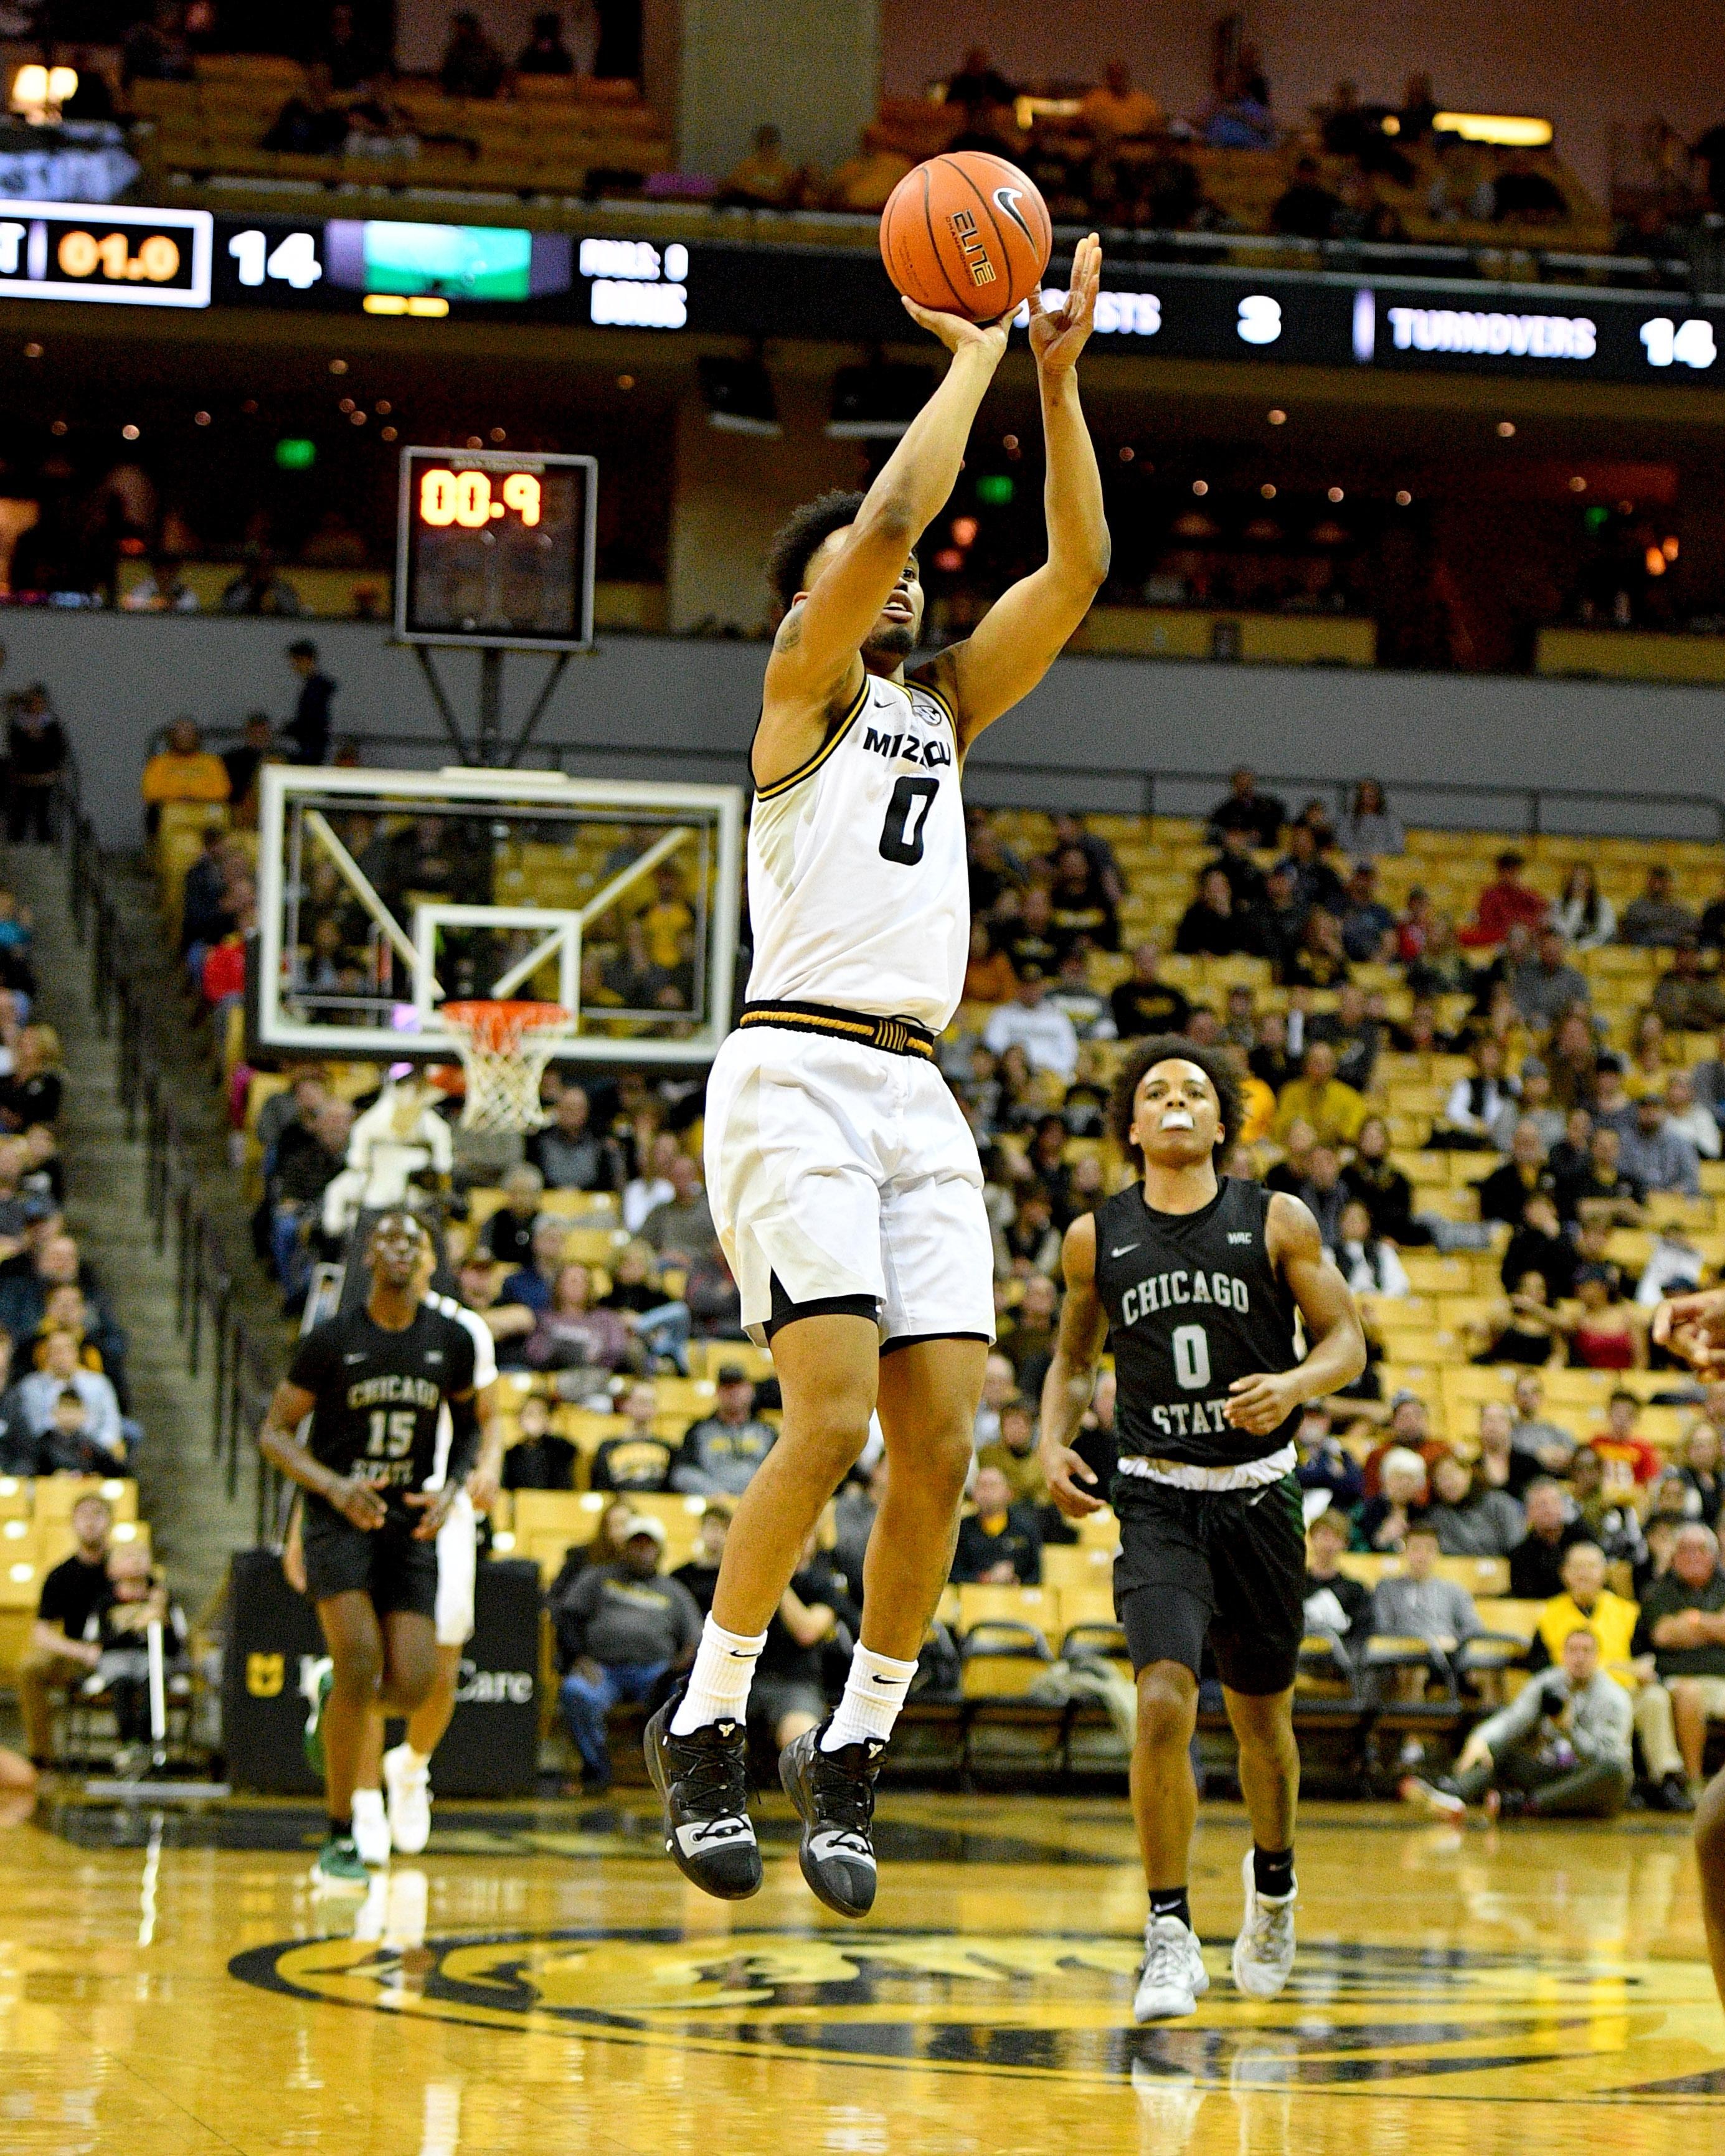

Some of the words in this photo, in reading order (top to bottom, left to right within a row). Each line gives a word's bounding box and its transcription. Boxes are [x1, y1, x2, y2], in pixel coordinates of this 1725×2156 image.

[57, 230, 180, 282] 01.0
[229, 230, 322, 288] 14
[952, 208, 996, 286] ELITE
[1387, 307, 1596, 360] TURNOVERS
[1640, 318, 1717, 369] 14
[420, 469, 541, 527] 00.9
[879, 776, 940, 866] 0
[1227, 1232, 1252, 1244] WAC
[1122, 1270, 1249, 1326] CHICAGO
[1172, 1324, 1211, 1390] 0
[367, 1410, 417, 1459] 15
[1152, 1399, 1231, 1435] STAT
